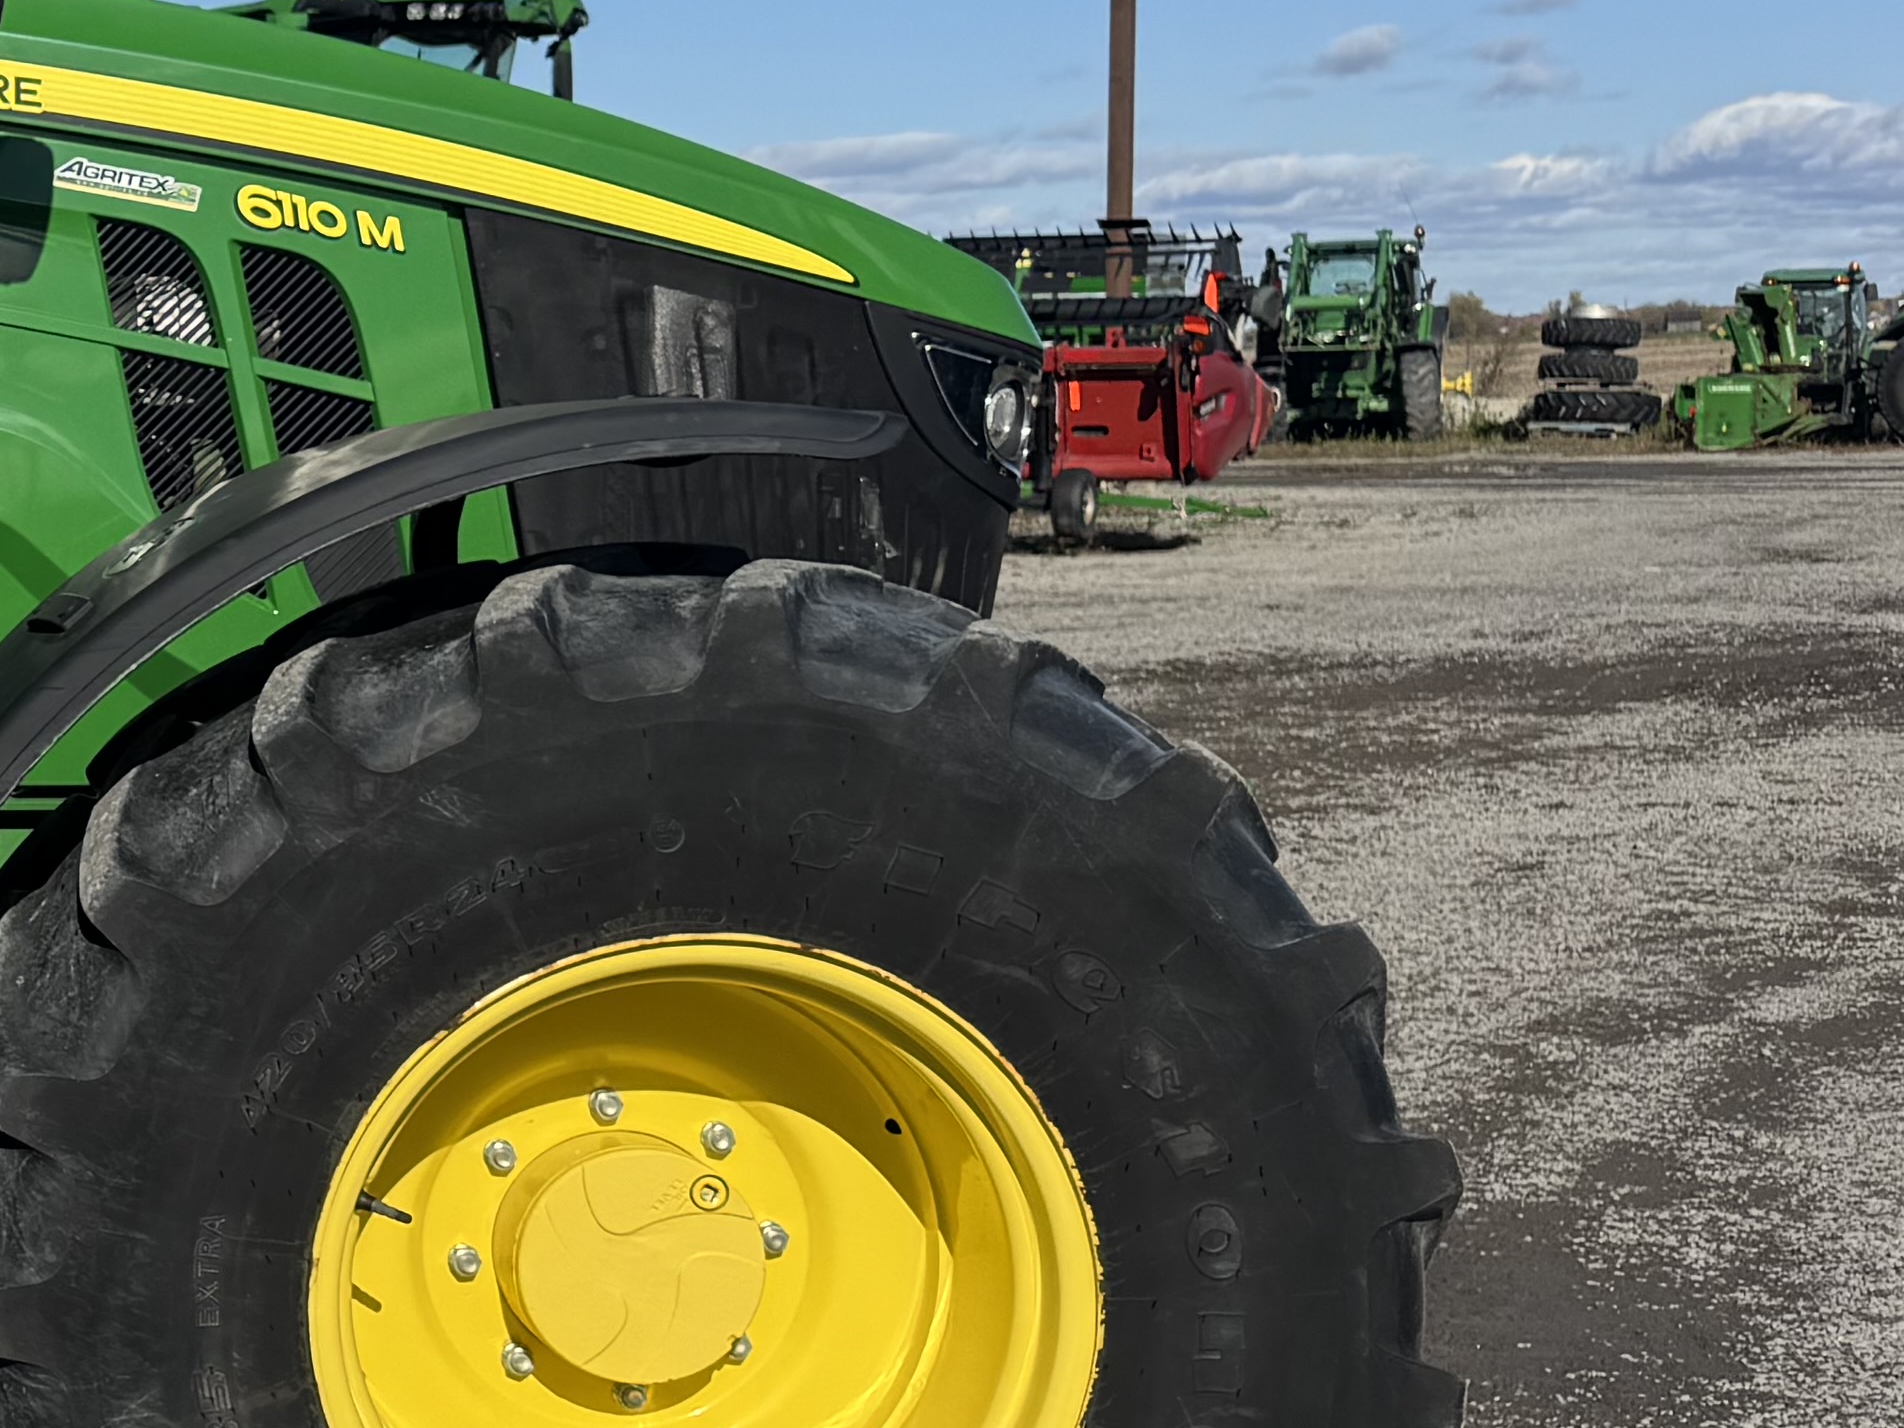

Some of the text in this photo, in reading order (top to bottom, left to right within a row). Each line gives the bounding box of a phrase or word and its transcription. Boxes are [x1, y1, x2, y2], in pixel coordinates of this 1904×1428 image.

[60, 160, 169, 192] AGRITEX
[237, 184, 405, 252] 6110 M
[192, 1212, 226, 1329] EXTRA
